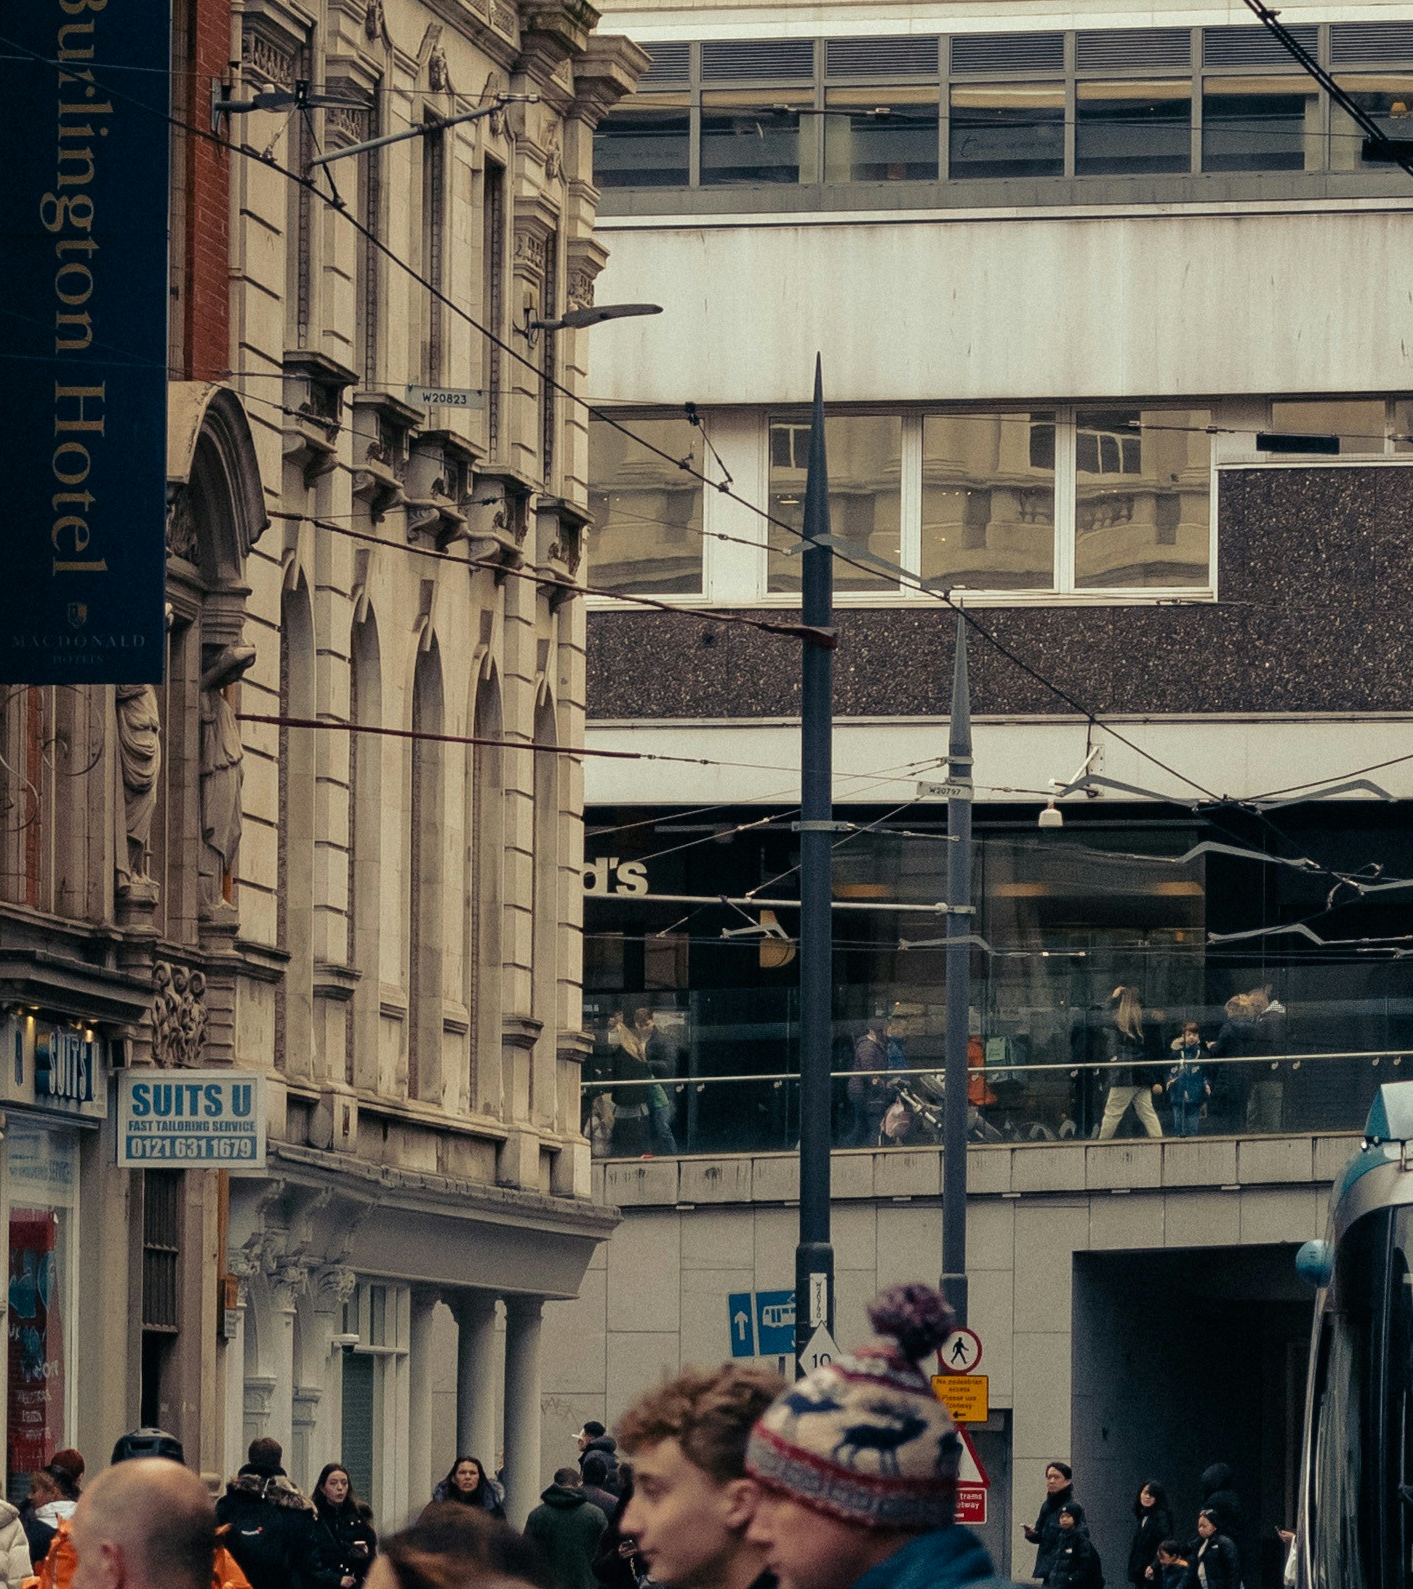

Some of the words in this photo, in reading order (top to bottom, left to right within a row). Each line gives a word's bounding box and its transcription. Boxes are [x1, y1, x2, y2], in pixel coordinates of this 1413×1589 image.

[422, 392, 467, 405] W20823
[51, 379, 109, 577] Hotel
[12, 632, 146, 649] MACDONALD
[48, 1031, 87, 1101] SUITS
[132, 1083, 223, 1117] SUITS
[232, 1084, 252, 1117] U
[129, 1120, 153, 1132] FAST
[156, 1120, 209, 1132] TAILORING
[212, 1120, 256, 1132] SERVICE
[131, 1138, 171, 1157] 0121
[175, 1138, 207, 1158] 631
[211, 1138, 252, 1158] 1679
[812, 1353, 832, 1368] 10
